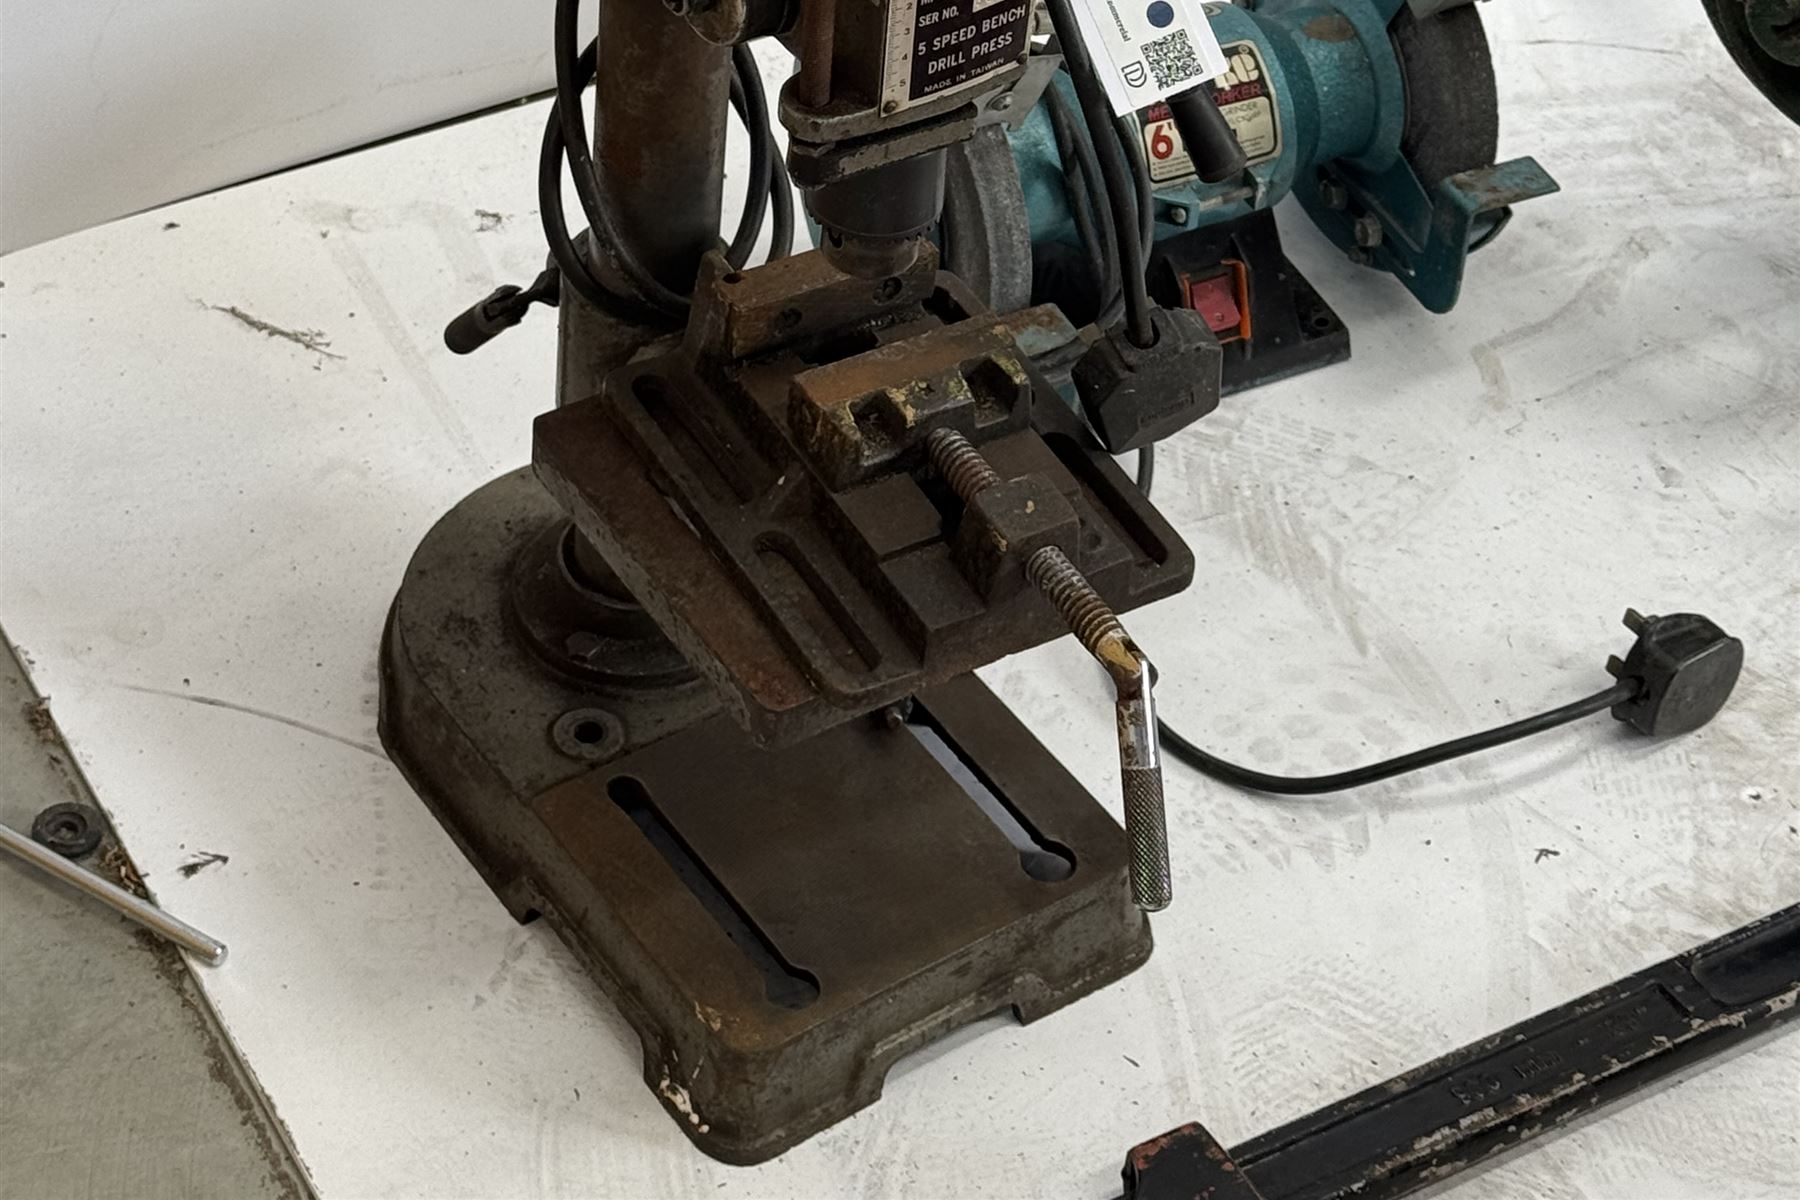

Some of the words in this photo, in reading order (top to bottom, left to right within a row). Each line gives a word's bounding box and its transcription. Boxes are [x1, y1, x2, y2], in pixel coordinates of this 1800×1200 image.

[918, 11, 939, 27] SER
[942, 6, 959, 20] NO.
[918, 42, 927, 56] 5
[932, 25, 977, 51] SPEED
[982, 4, 1026, 34] BENCH
[928, 51, 966, 75] DRILL
[971, 32, 1014, 59] PRESS
[923, 79, 952, 93] MADE
[956, 73, 966, 82] IN
[971, 58, 1004, 76] TAIWAN
